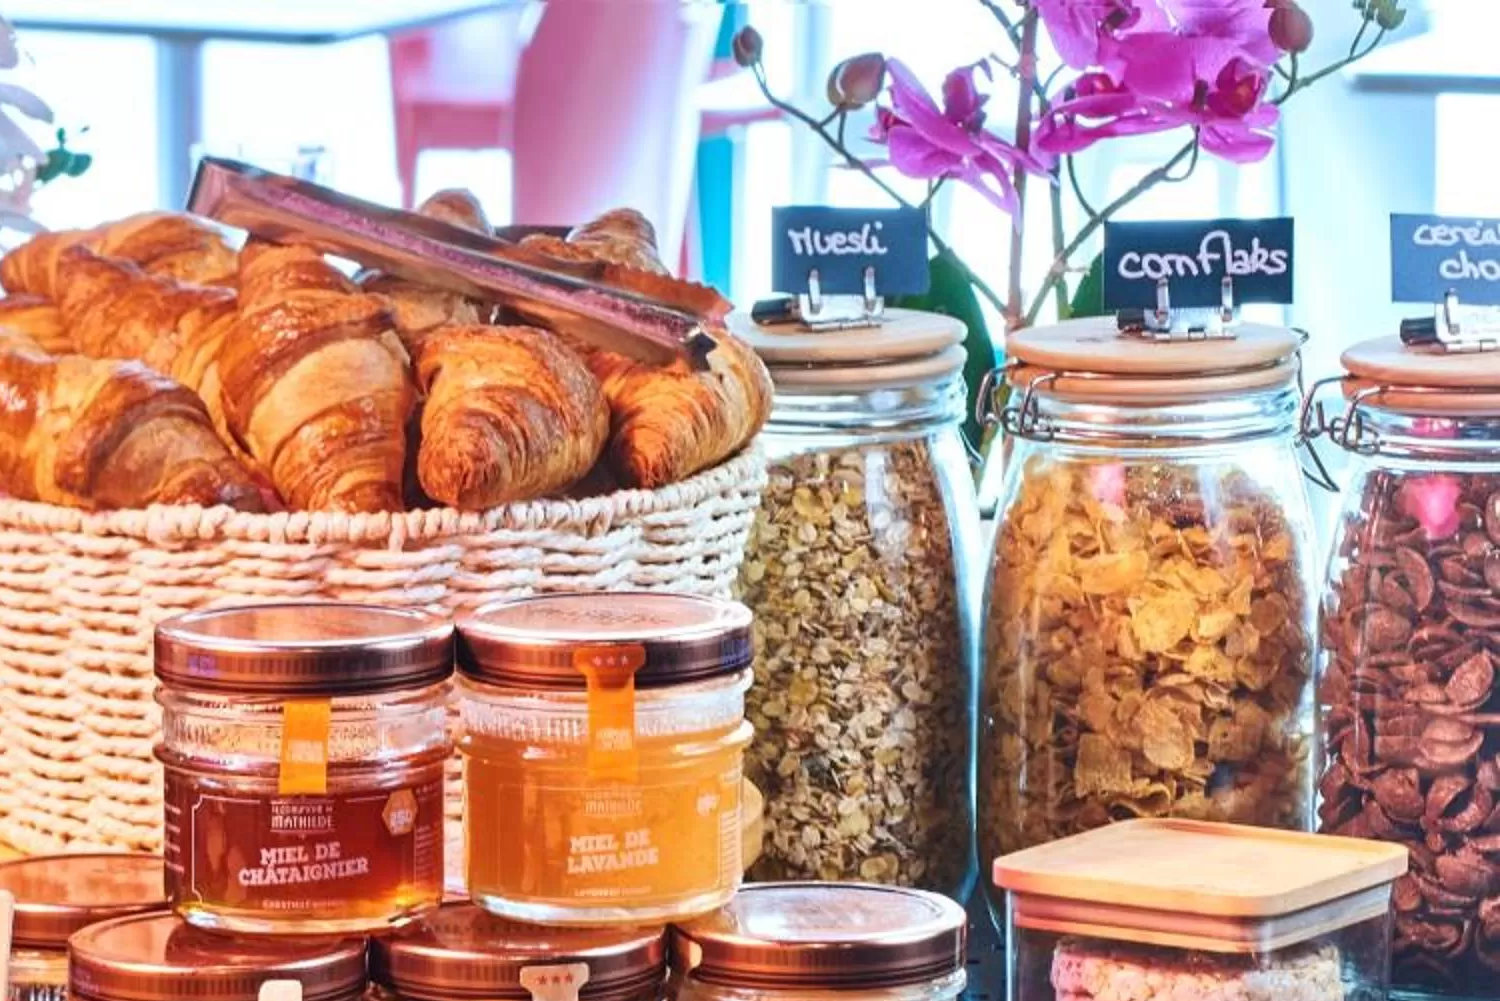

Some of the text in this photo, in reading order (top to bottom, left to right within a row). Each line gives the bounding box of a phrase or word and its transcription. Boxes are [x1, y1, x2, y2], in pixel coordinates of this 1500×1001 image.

[259, 841, 340, 866] MIEL DE
[569, 829, 650, 854] MIEL DE
[238, 857, 369, 887] CHÂTAIGNIER
[567, 847, 659, 874] LAVANDE
